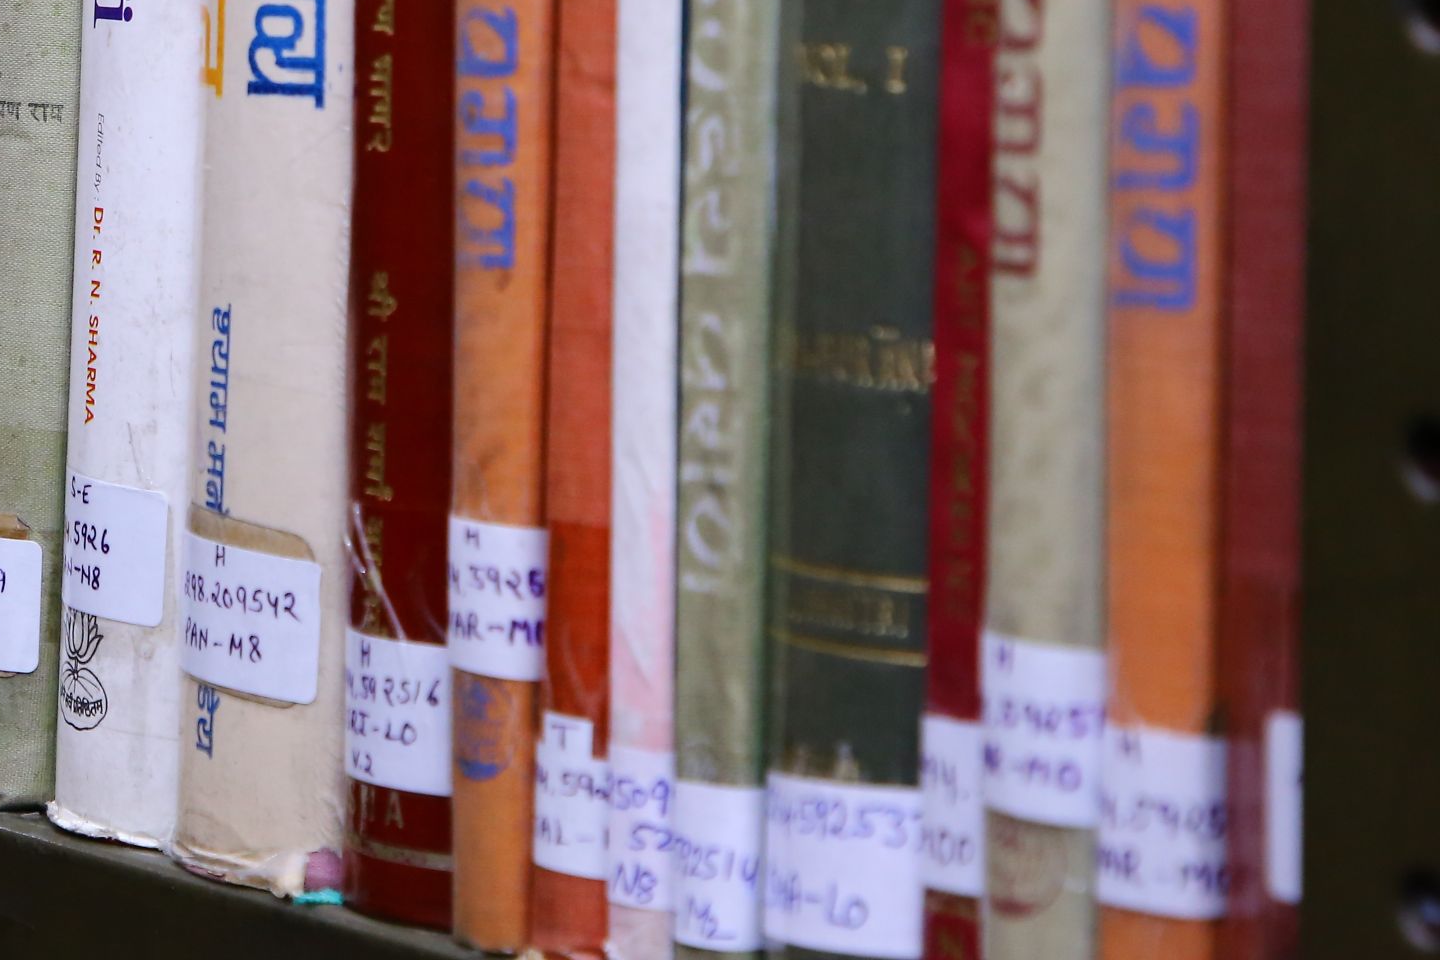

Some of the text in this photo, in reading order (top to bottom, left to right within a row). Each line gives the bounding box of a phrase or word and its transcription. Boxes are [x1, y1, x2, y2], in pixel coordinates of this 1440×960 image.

[94, 112, 105, 170] Edited
[93, 172, 102, 193] By
[91, 206, 104, 240] Dr.
[91, 249, 102, 271] R.
[89, 279, 101, 306] N.
[83, 315, 100, 426] SHARMA
[209, 303, 231, 434] श्याम
[214, 544, 227, 568] H
